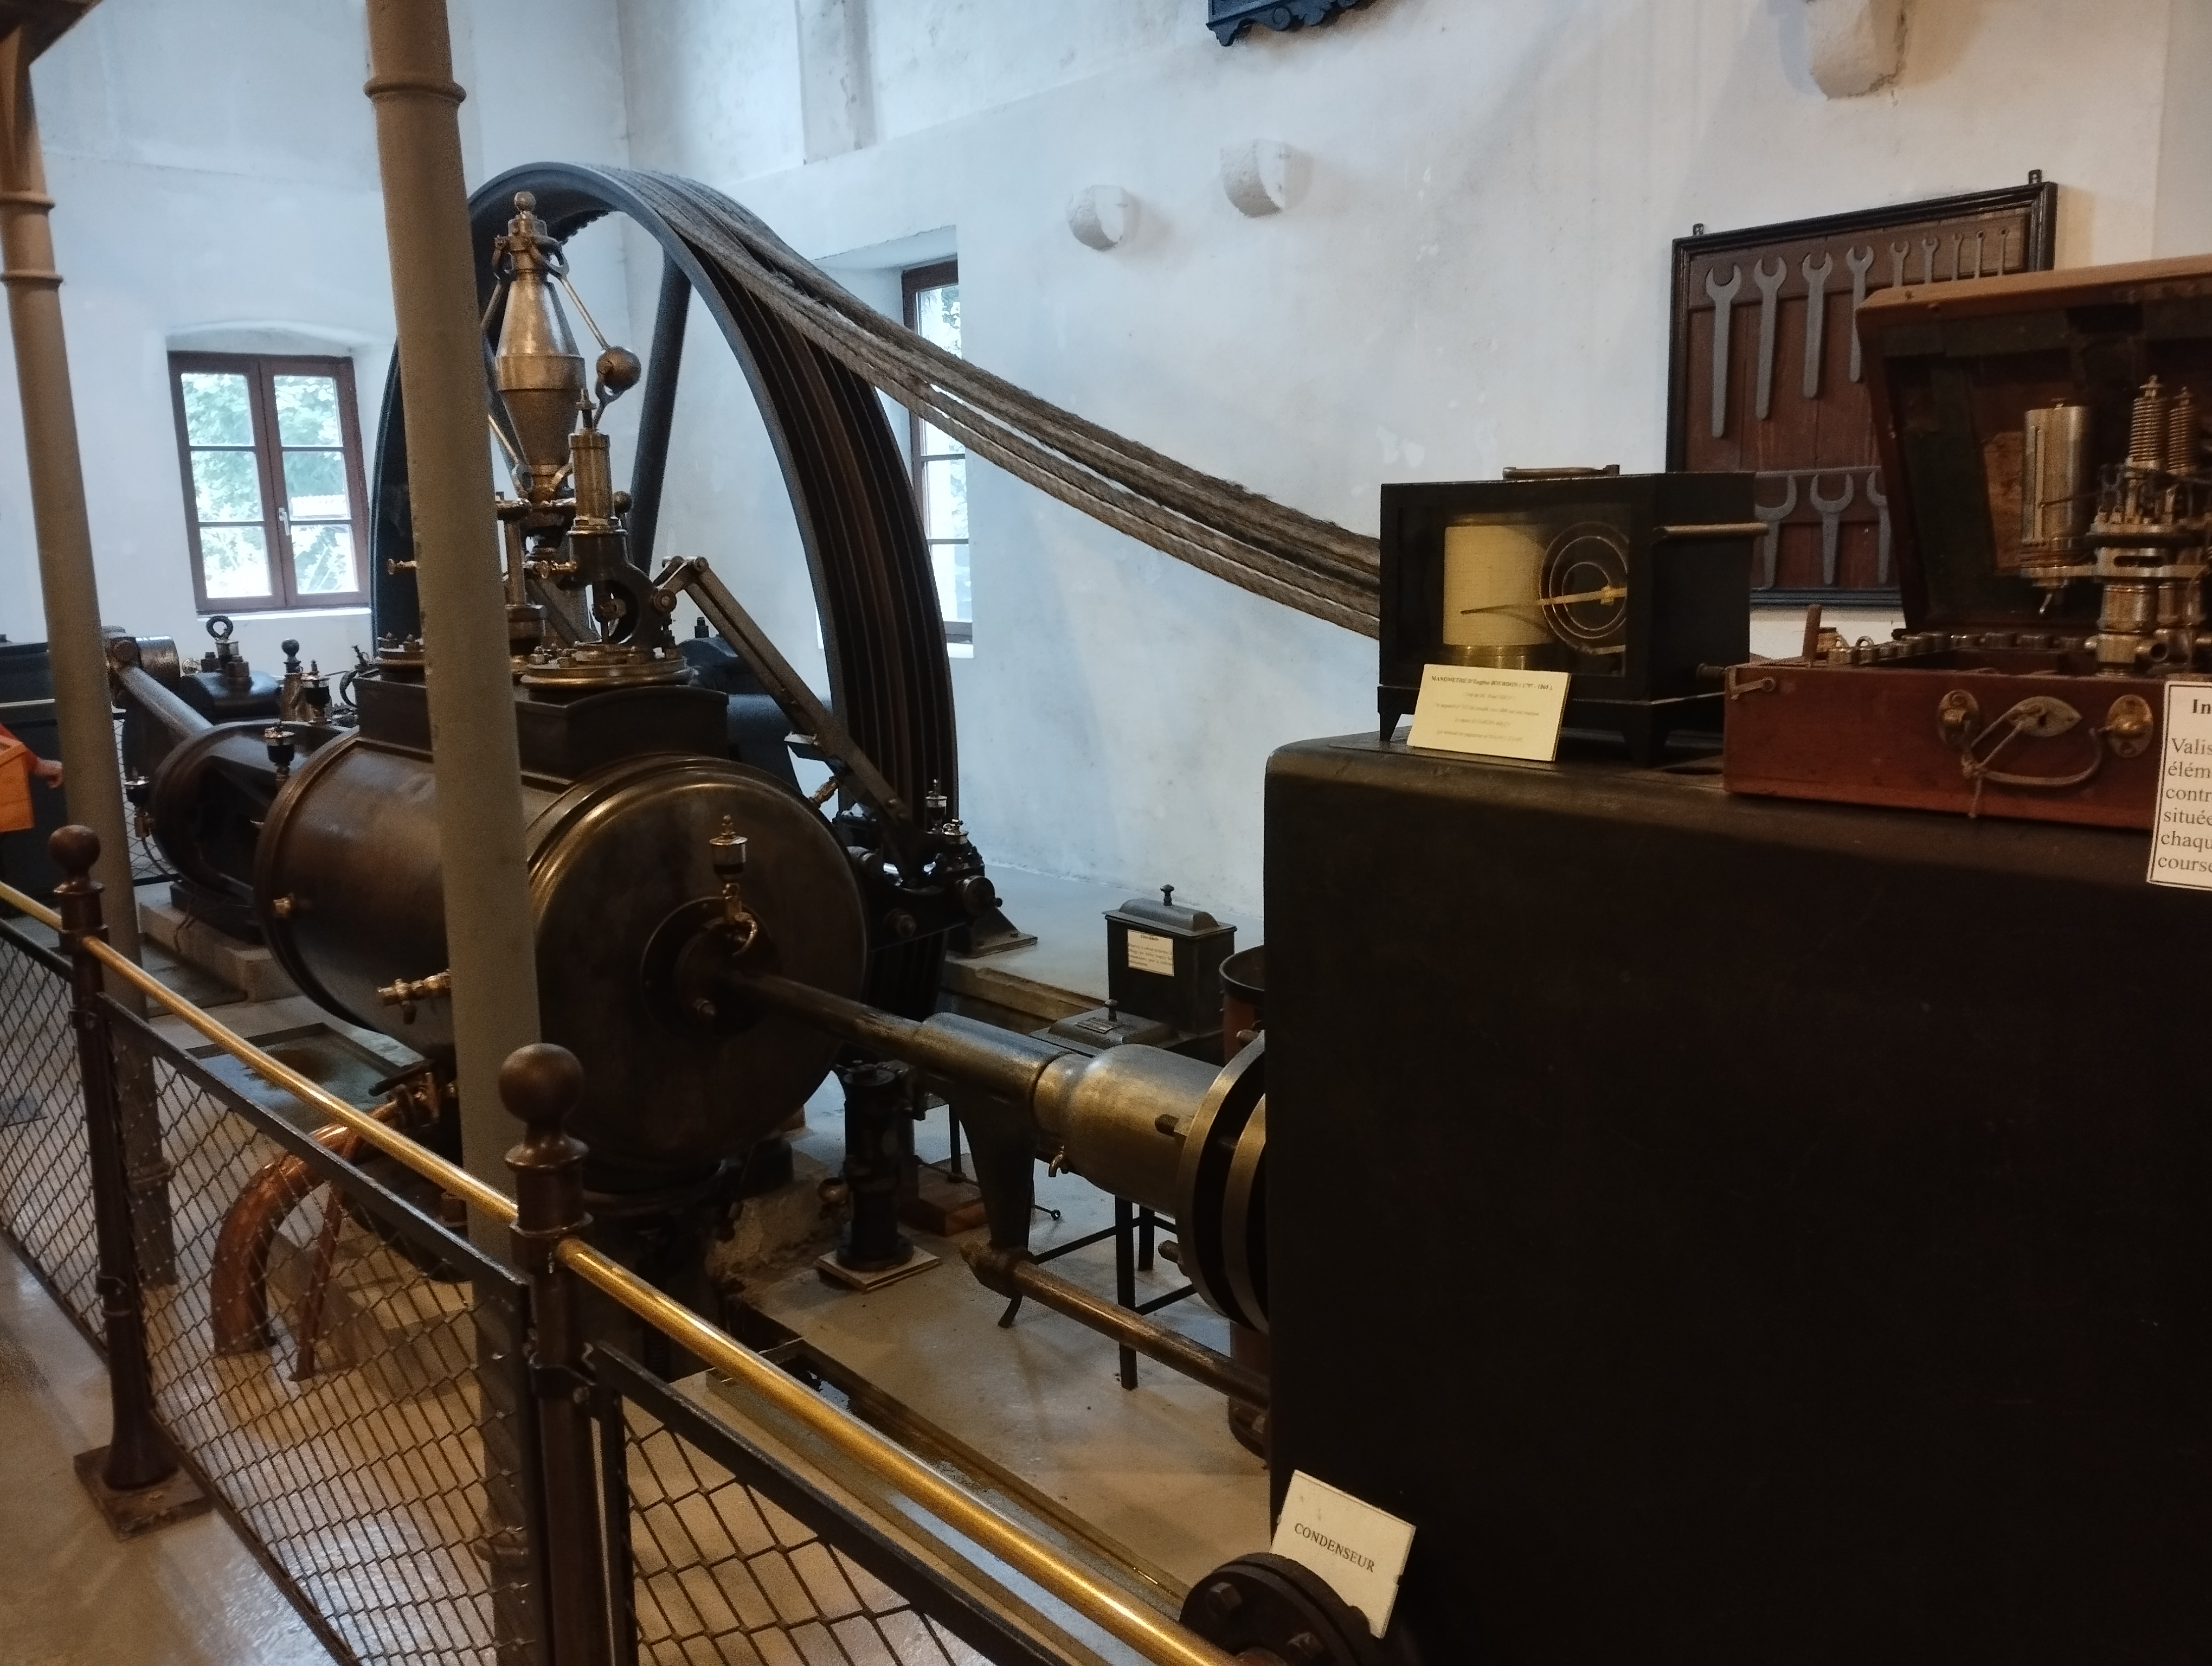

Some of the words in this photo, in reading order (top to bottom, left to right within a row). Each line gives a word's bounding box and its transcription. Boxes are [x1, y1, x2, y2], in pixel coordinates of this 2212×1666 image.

[2168, 761, 2211, 778] élém
[2166, 789, 2212, 802] contr
[1295, 1523, 1374, 1573] CONDENSEUR
